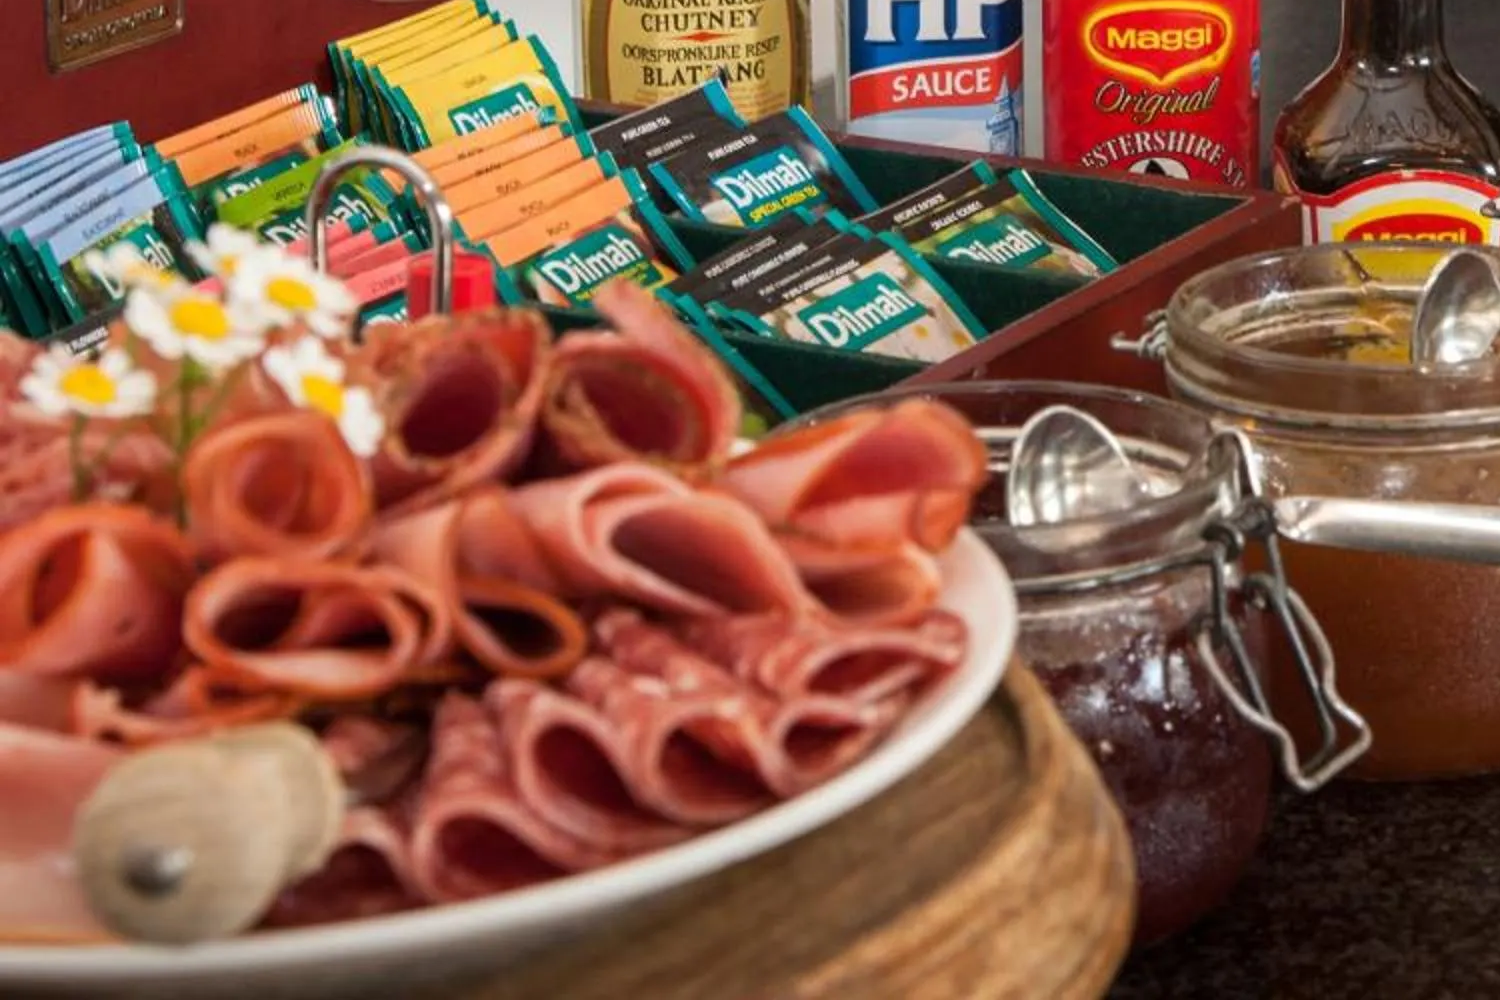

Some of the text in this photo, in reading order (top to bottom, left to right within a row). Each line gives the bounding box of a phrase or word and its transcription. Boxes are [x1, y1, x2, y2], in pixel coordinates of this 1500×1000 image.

[641, 6, 763, 33] CHUTNEY
[1107, 24, 1212, 51] Maggi
[641, 59, 766, 87] BLATANG
[892, 67, 991, 103] SAUCE
[1095, 75, 1221, 125] Original
[1081, 130, 1224, 168] ESTERSHIRE
[714, 153, 812, 208] Dilmah
[540, 232, 642, 294] Dilmah
[808, 283, 916, 348] Dilmah
